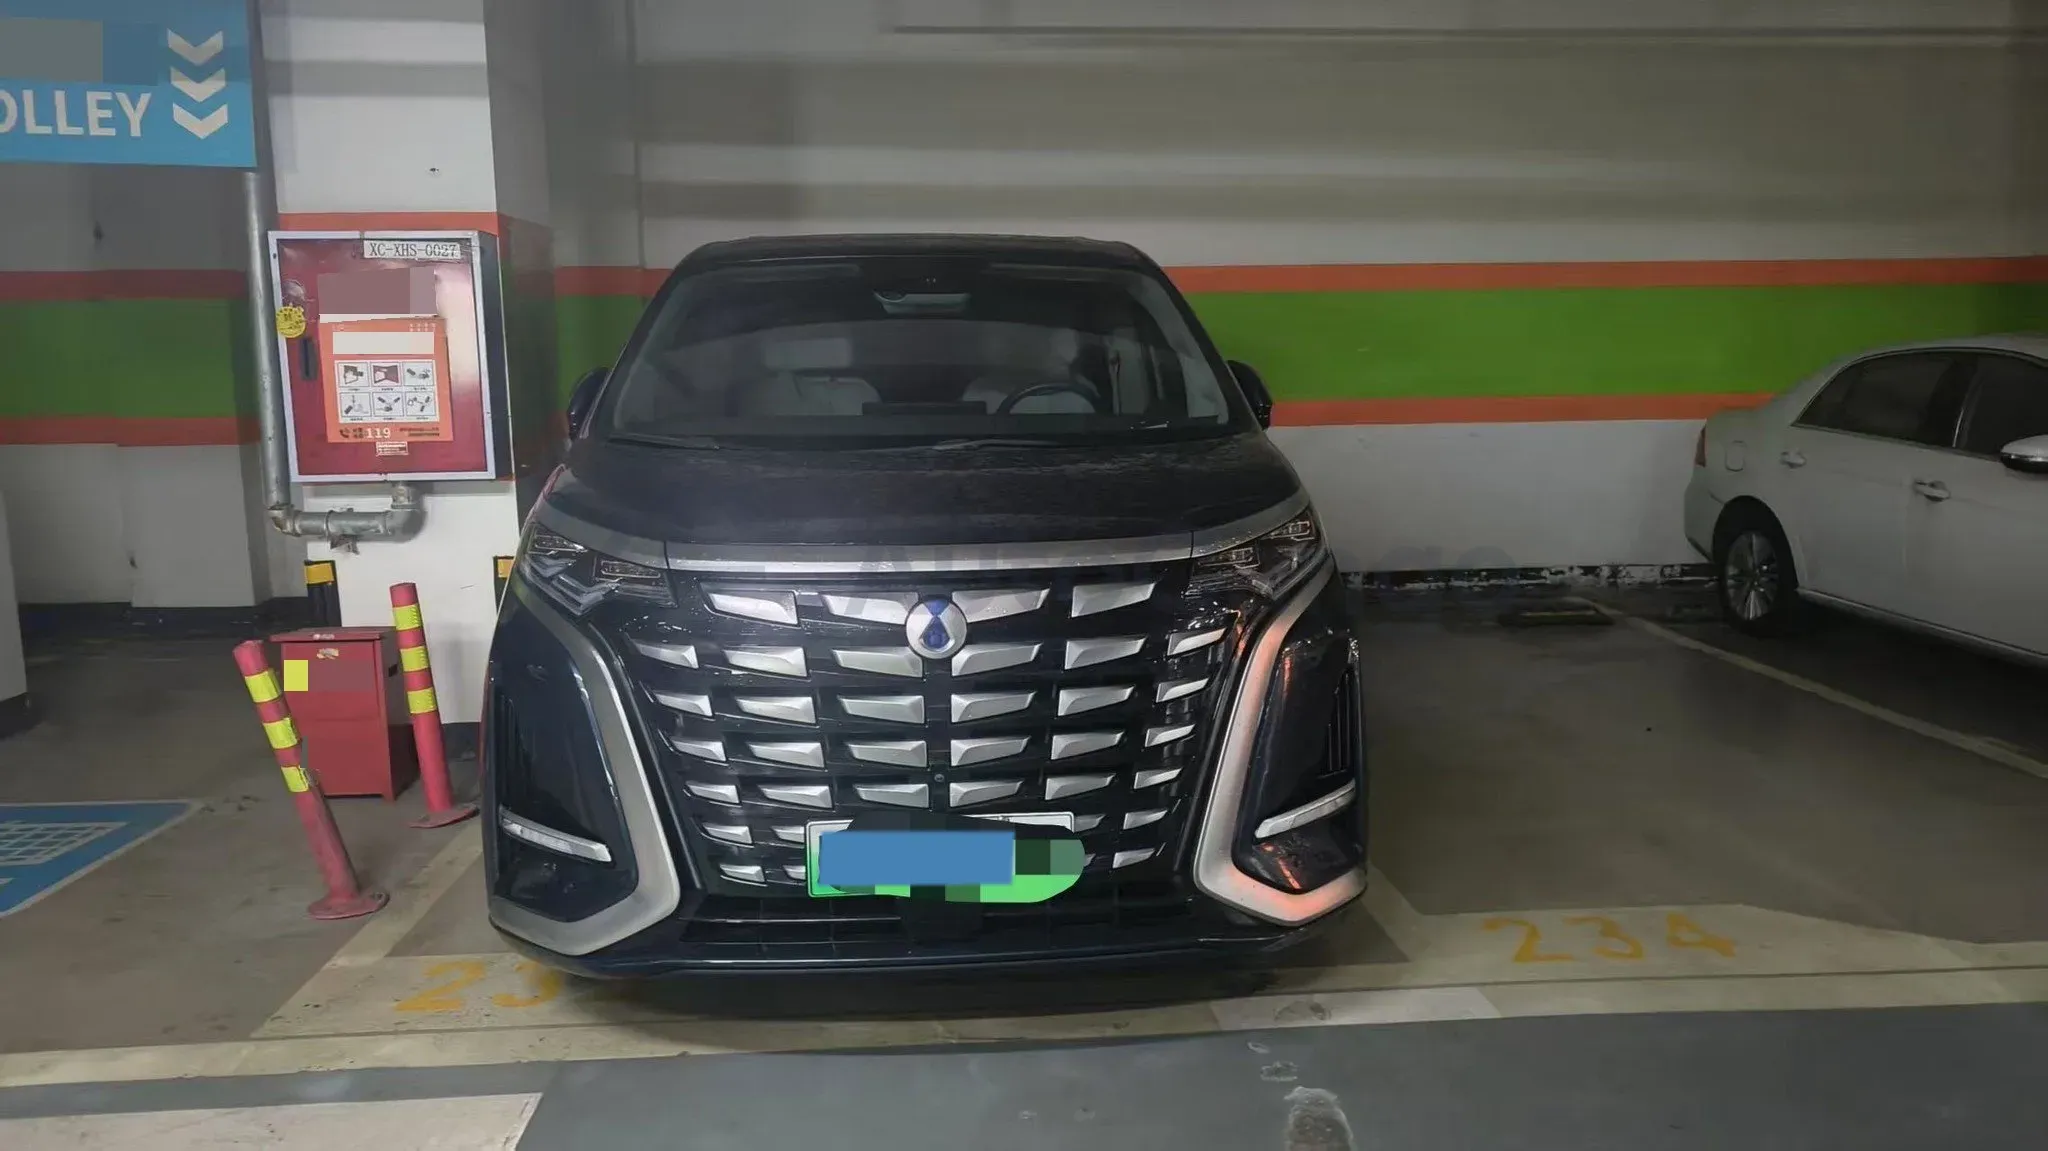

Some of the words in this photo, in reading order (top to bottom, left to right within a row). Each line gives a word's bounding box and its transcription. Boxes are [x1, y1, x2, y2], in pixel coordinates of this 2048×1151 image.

[369, 242, 457, 258] XC-XHS-0027
[365, 427, 392, 439] 119
[1481, 911, 1737, 963] 234
